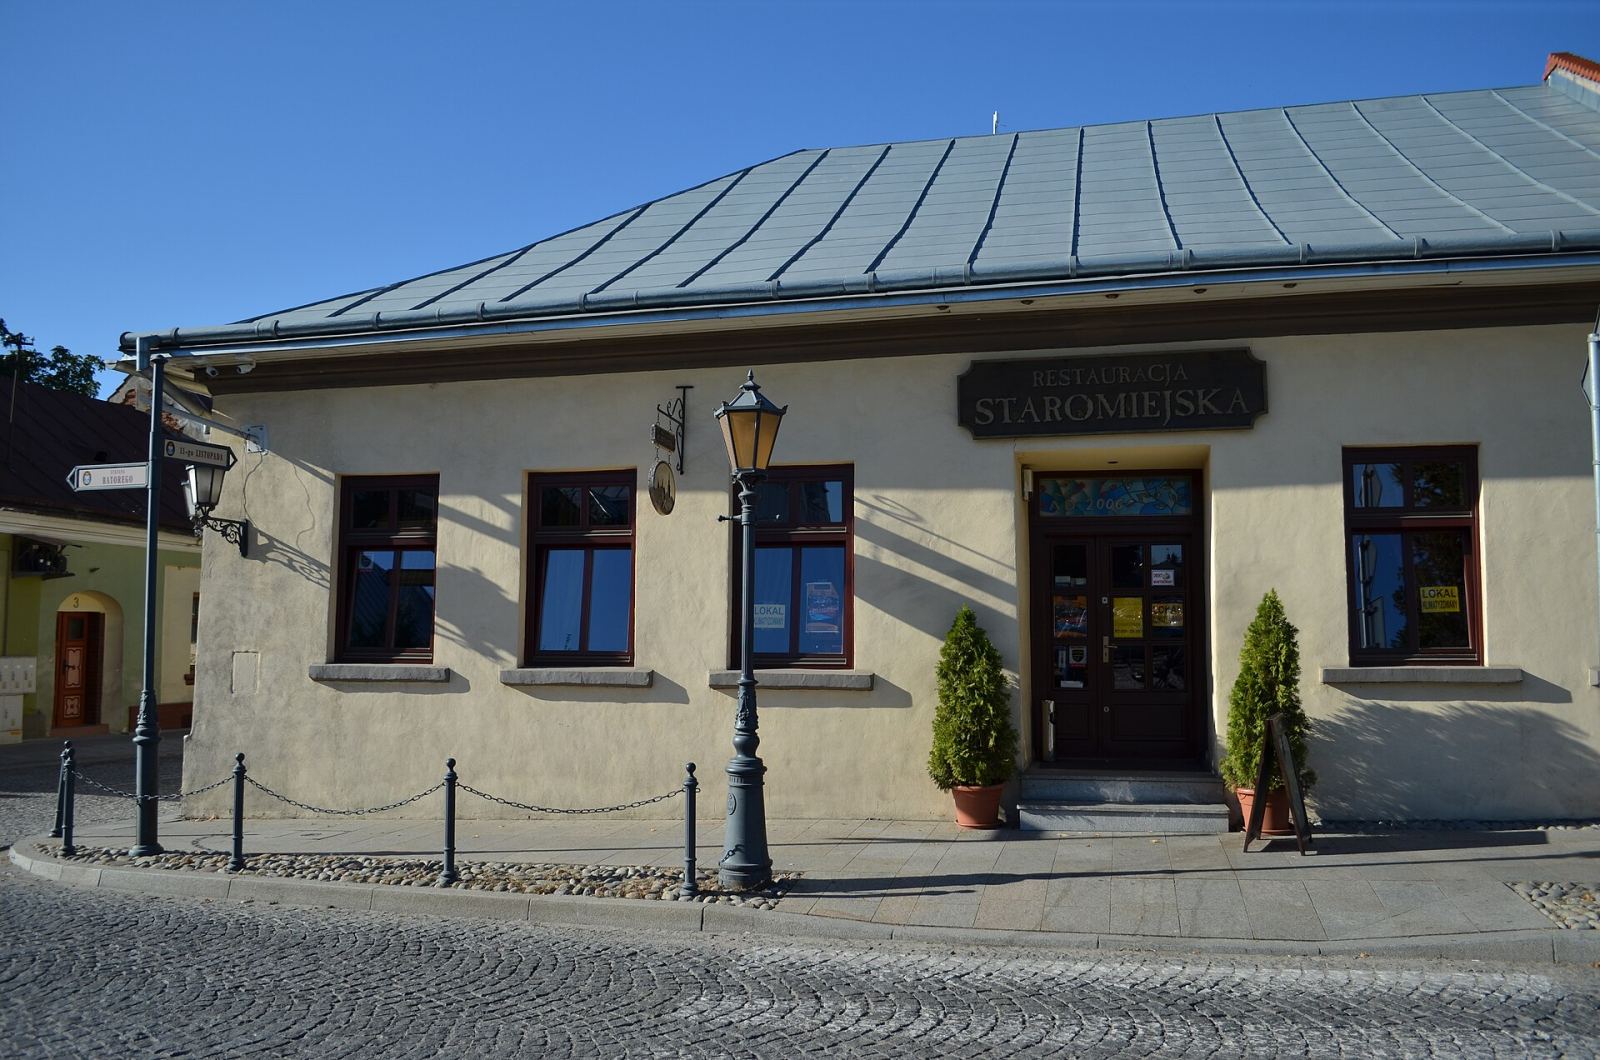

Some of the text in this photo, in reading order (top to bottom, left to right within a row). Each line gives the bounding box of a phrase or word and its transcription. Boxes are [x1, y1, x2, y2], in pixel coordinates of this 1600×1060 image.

[1032, 364, 1188, 387] RESTAURACJA
[975, 388, 1250, 426] STAROMIEJSKA
[195, 449, 224, 461] LISTOPADA
[102, 475, 134, 484] BATOREGO
[1422, 588, 1456, 598] LOKAL
[73, 597, 79, 608] 3
[754, 606, 784, 615] LOKAL
